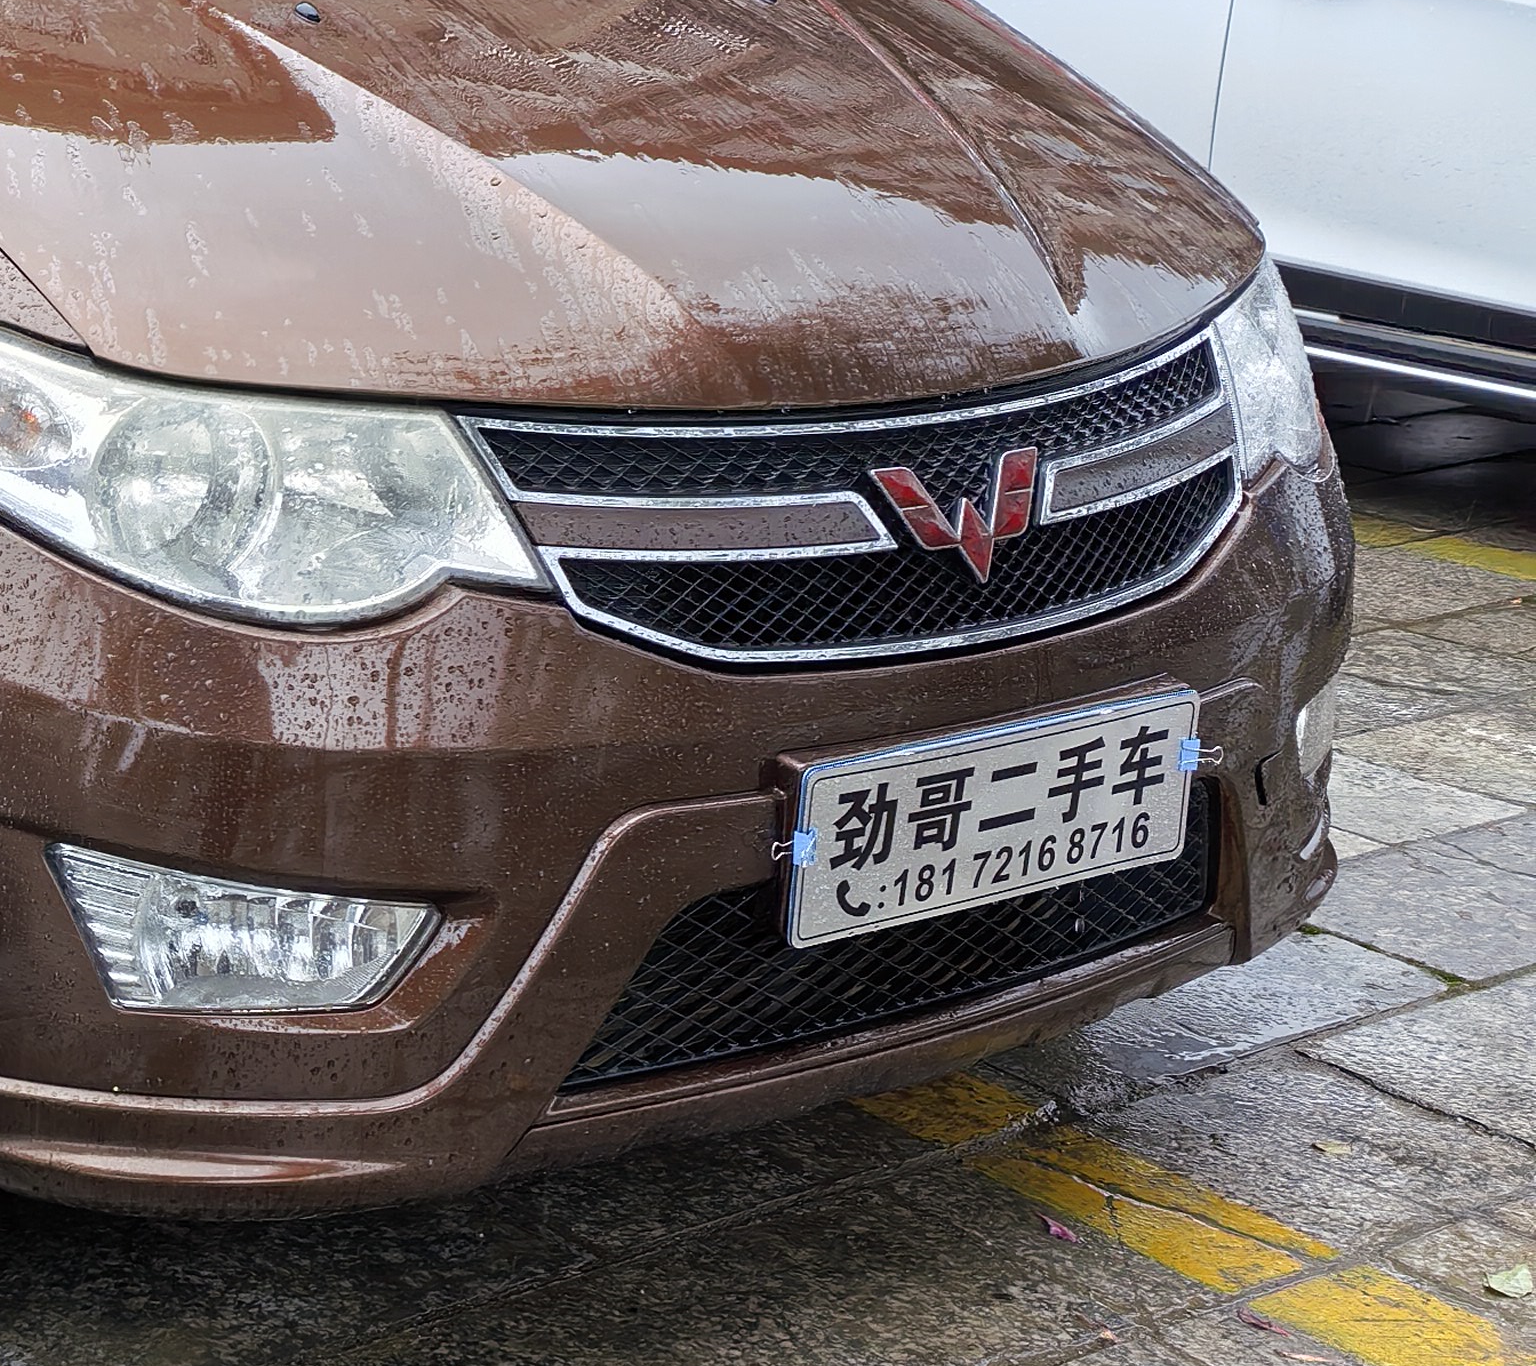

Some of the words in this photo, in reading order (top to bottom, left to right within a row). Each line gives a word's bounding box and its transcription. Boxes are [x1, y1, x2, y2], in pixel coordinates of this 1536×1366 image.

[830, 725, 1170, 872] 劲哥二手车
